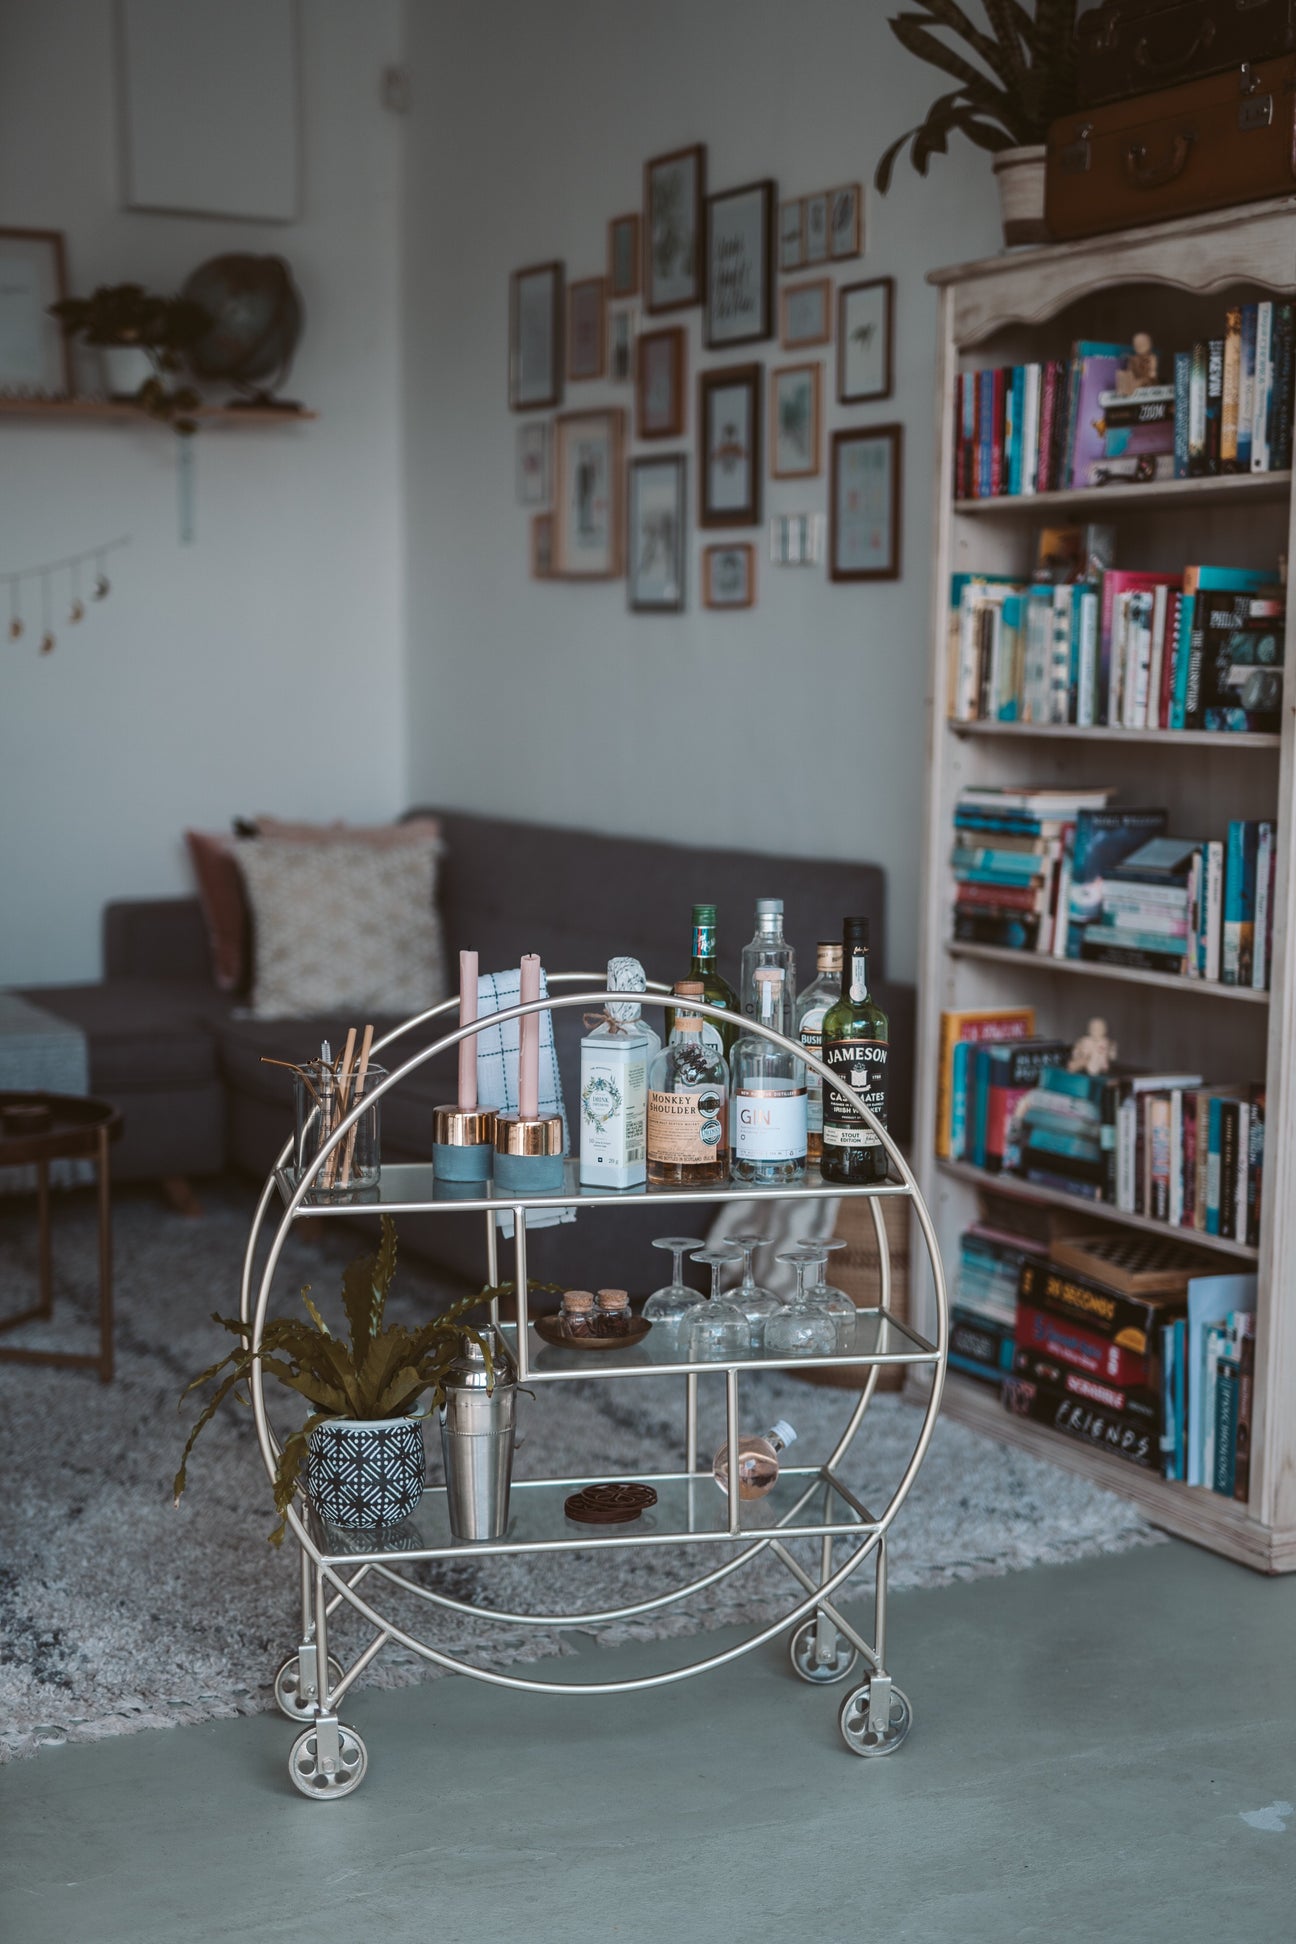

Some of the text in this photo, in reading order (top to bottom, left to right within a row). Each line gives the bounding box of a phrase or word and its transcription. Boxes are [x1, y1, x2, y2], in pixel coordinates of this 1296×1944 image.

[827, 1047, 887, 1065] JAMESON
[652, 1093, 691, 1105] MONKEY
[649, 1102, 696, 1115] SHOULDER
[833, 1106, 852, 1114] IRISH
[740, 1108, 771, 1126] GIN
[1055, 1399, 1151, 1458] FRIENDS
